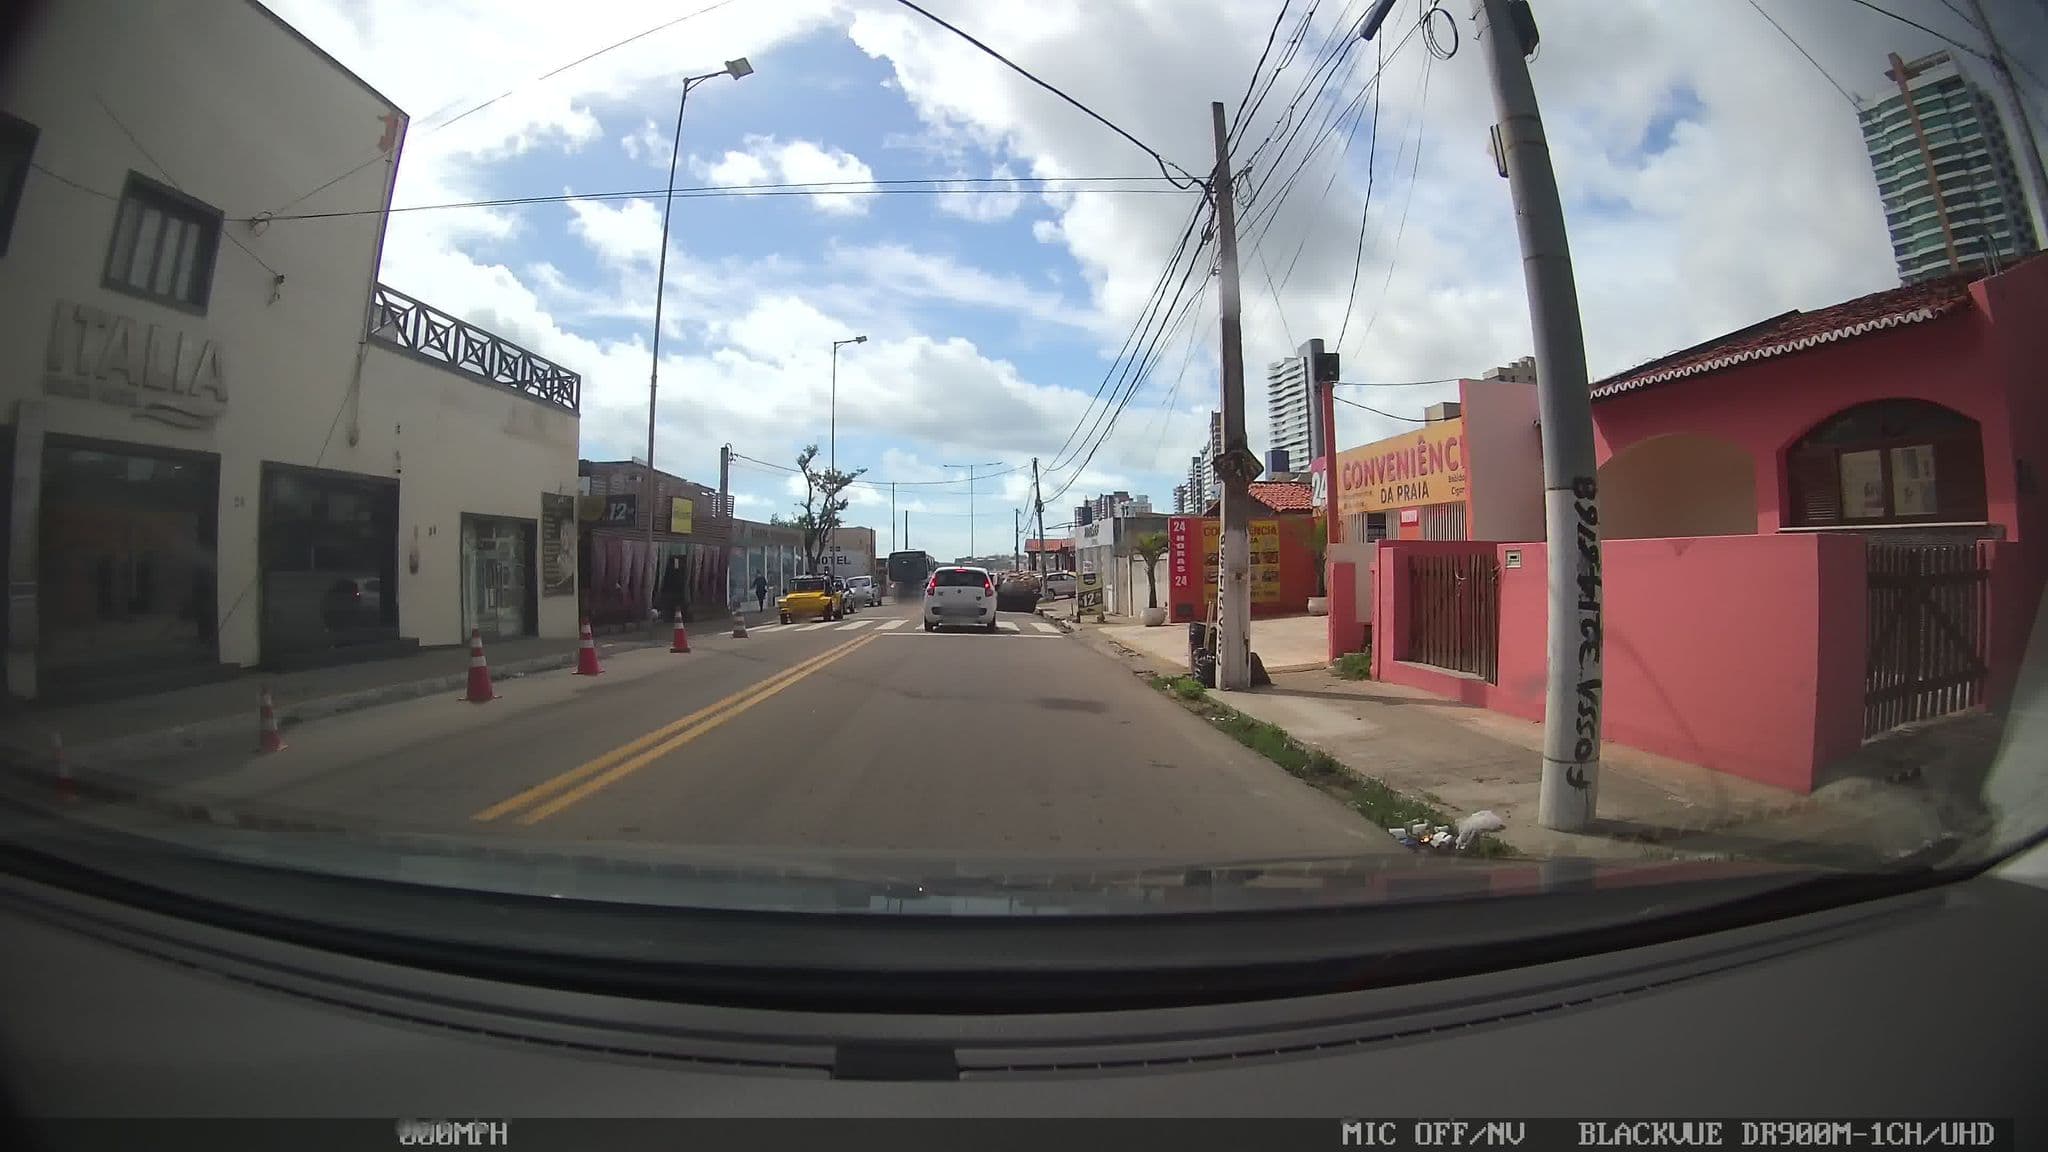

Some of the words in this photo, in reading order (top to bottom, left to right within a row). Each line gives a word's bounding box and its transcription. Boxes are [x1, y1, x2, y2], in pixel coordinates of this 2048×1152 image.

[46, 299, 228, 402] ITALIA
[1380, 487, 1394, 504] DA
[1397, 481, 1430, 502] PRAIA
[608, 503, 627, 521] 12
[1173, 521, 1186, 532] 24
[818, 556, 851, 565] OTEL
[1175, 576, 1188, 587] 24
[1082, 593, 1095, 606] 12
